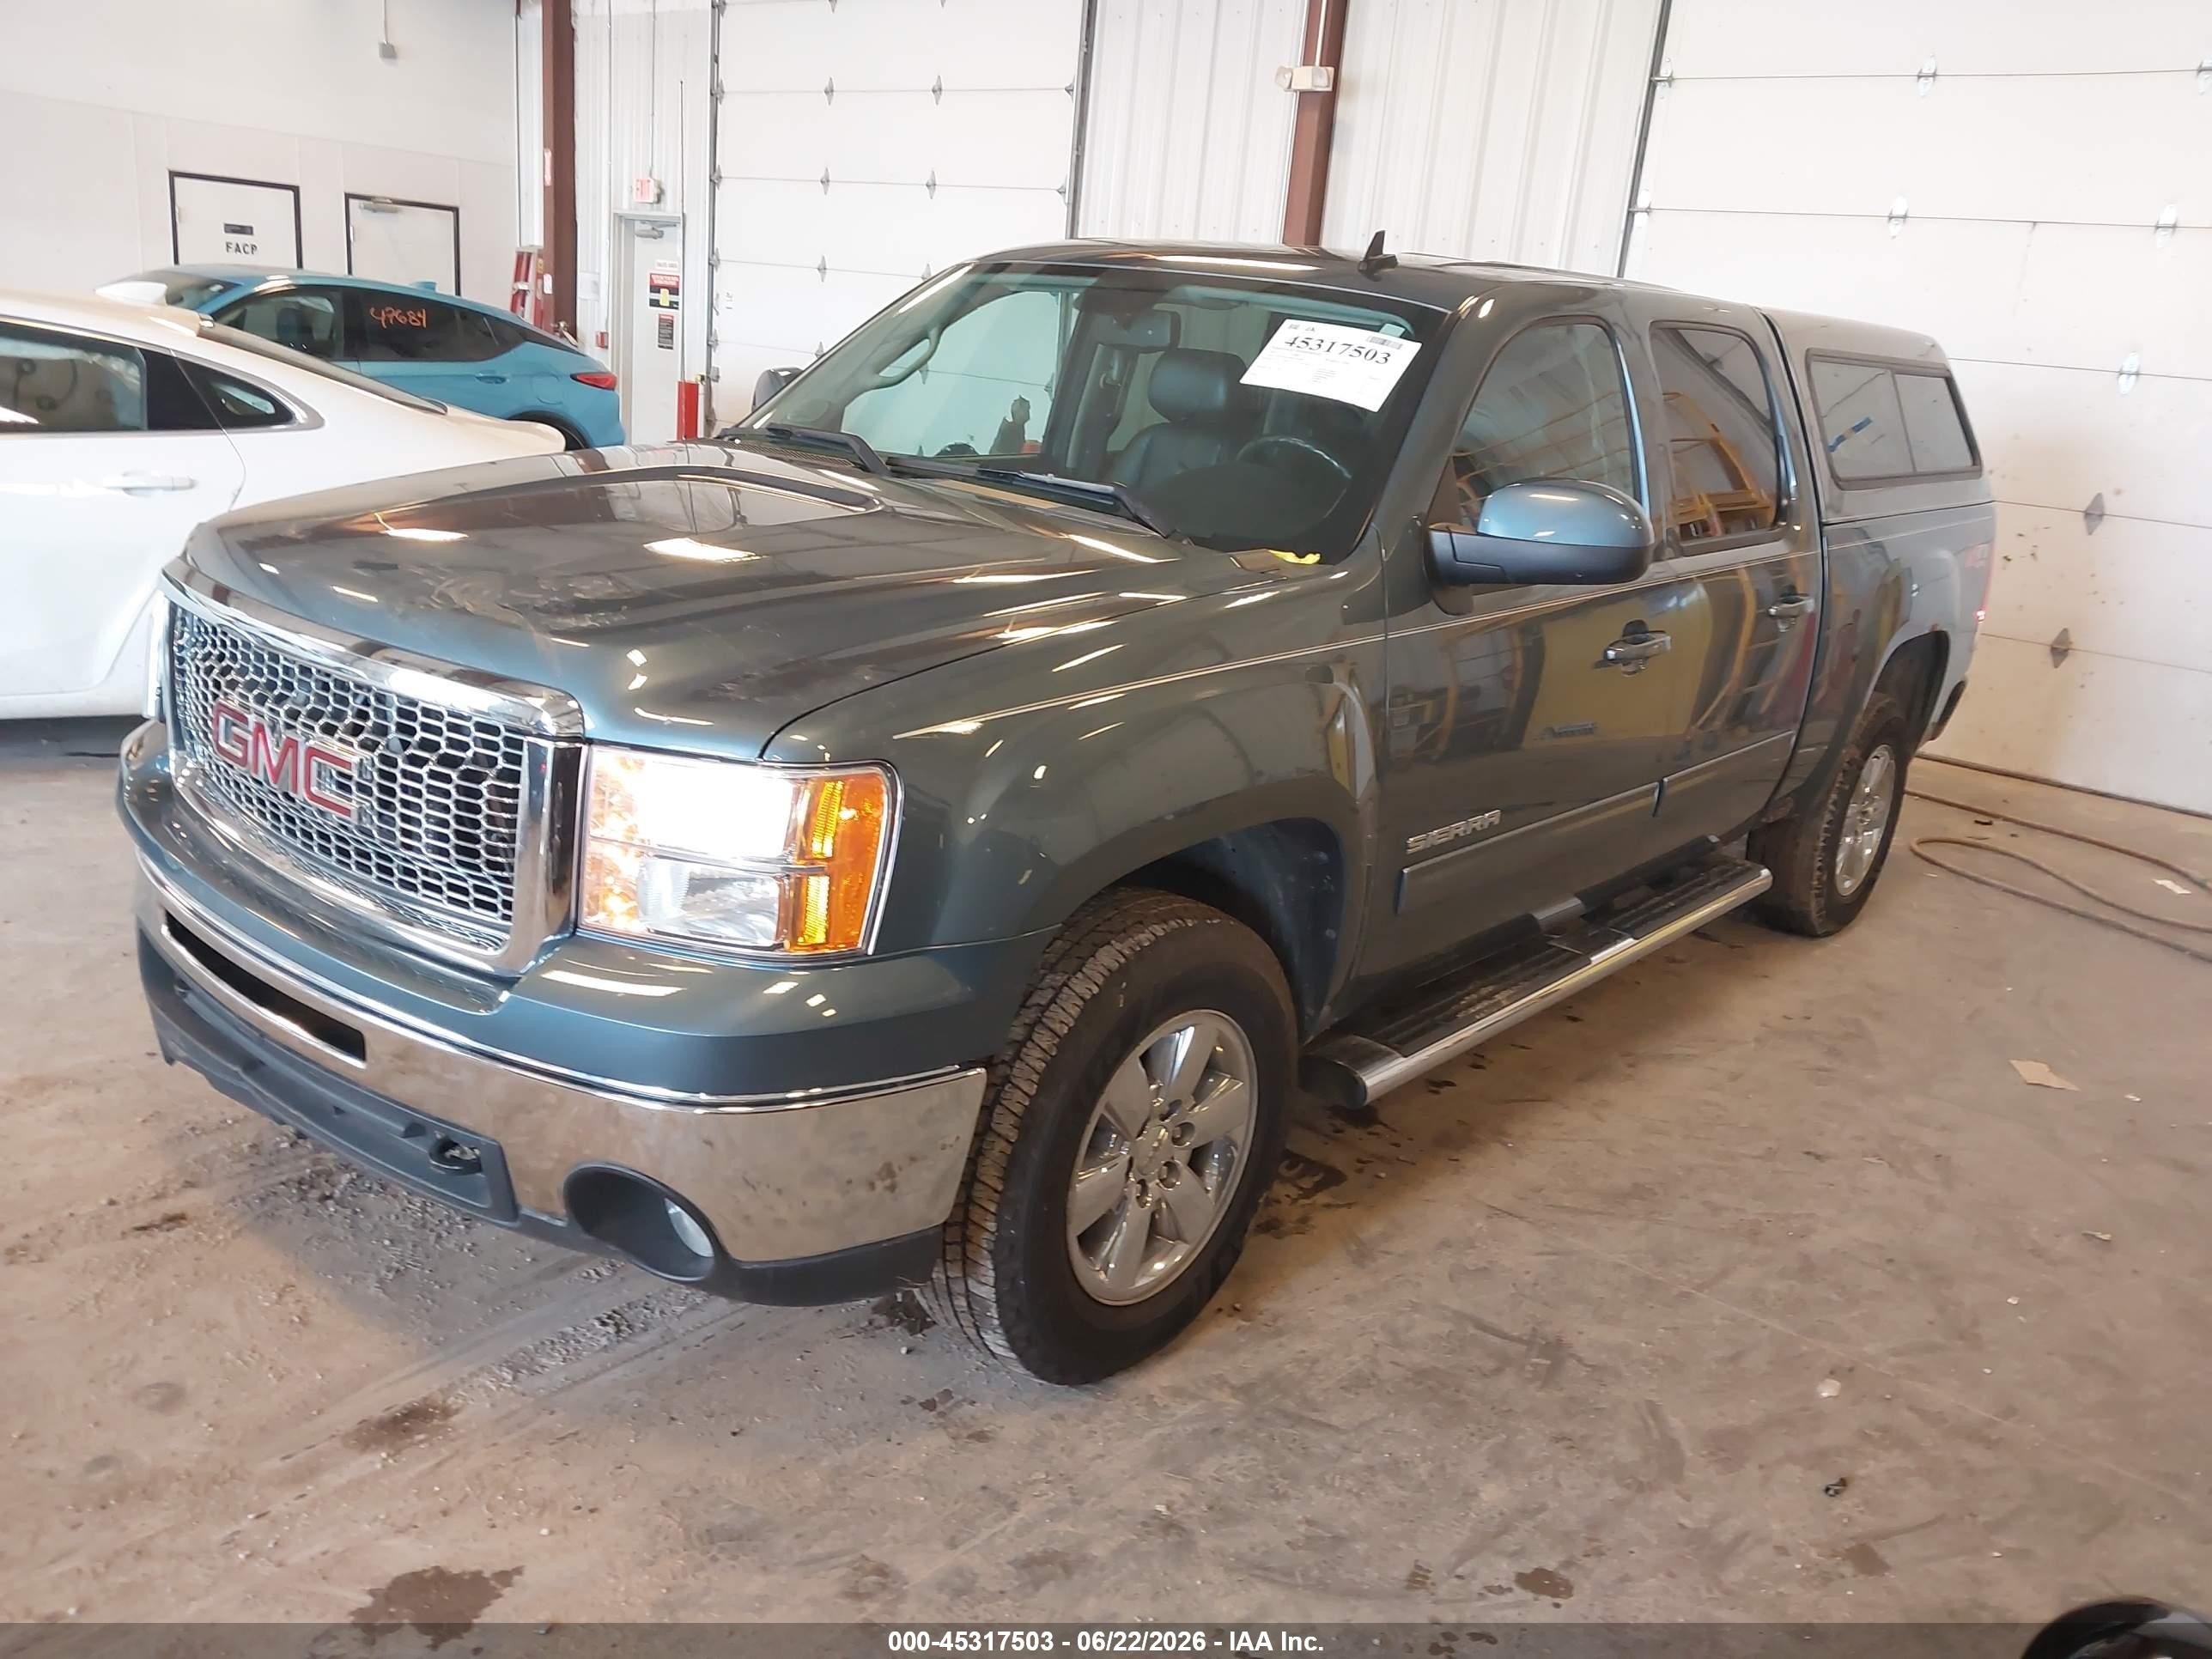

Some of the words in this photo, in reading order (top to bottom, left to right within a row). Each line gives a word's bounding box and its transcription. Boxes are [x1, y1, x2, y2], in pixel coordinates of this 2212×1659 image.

[225, 241, 258, 255] FACP
[1285, 336, 1391, 365] 45317503
[212, 697, 361, 823] GMC
[1406, 809, 1501, 854] SIERRA
